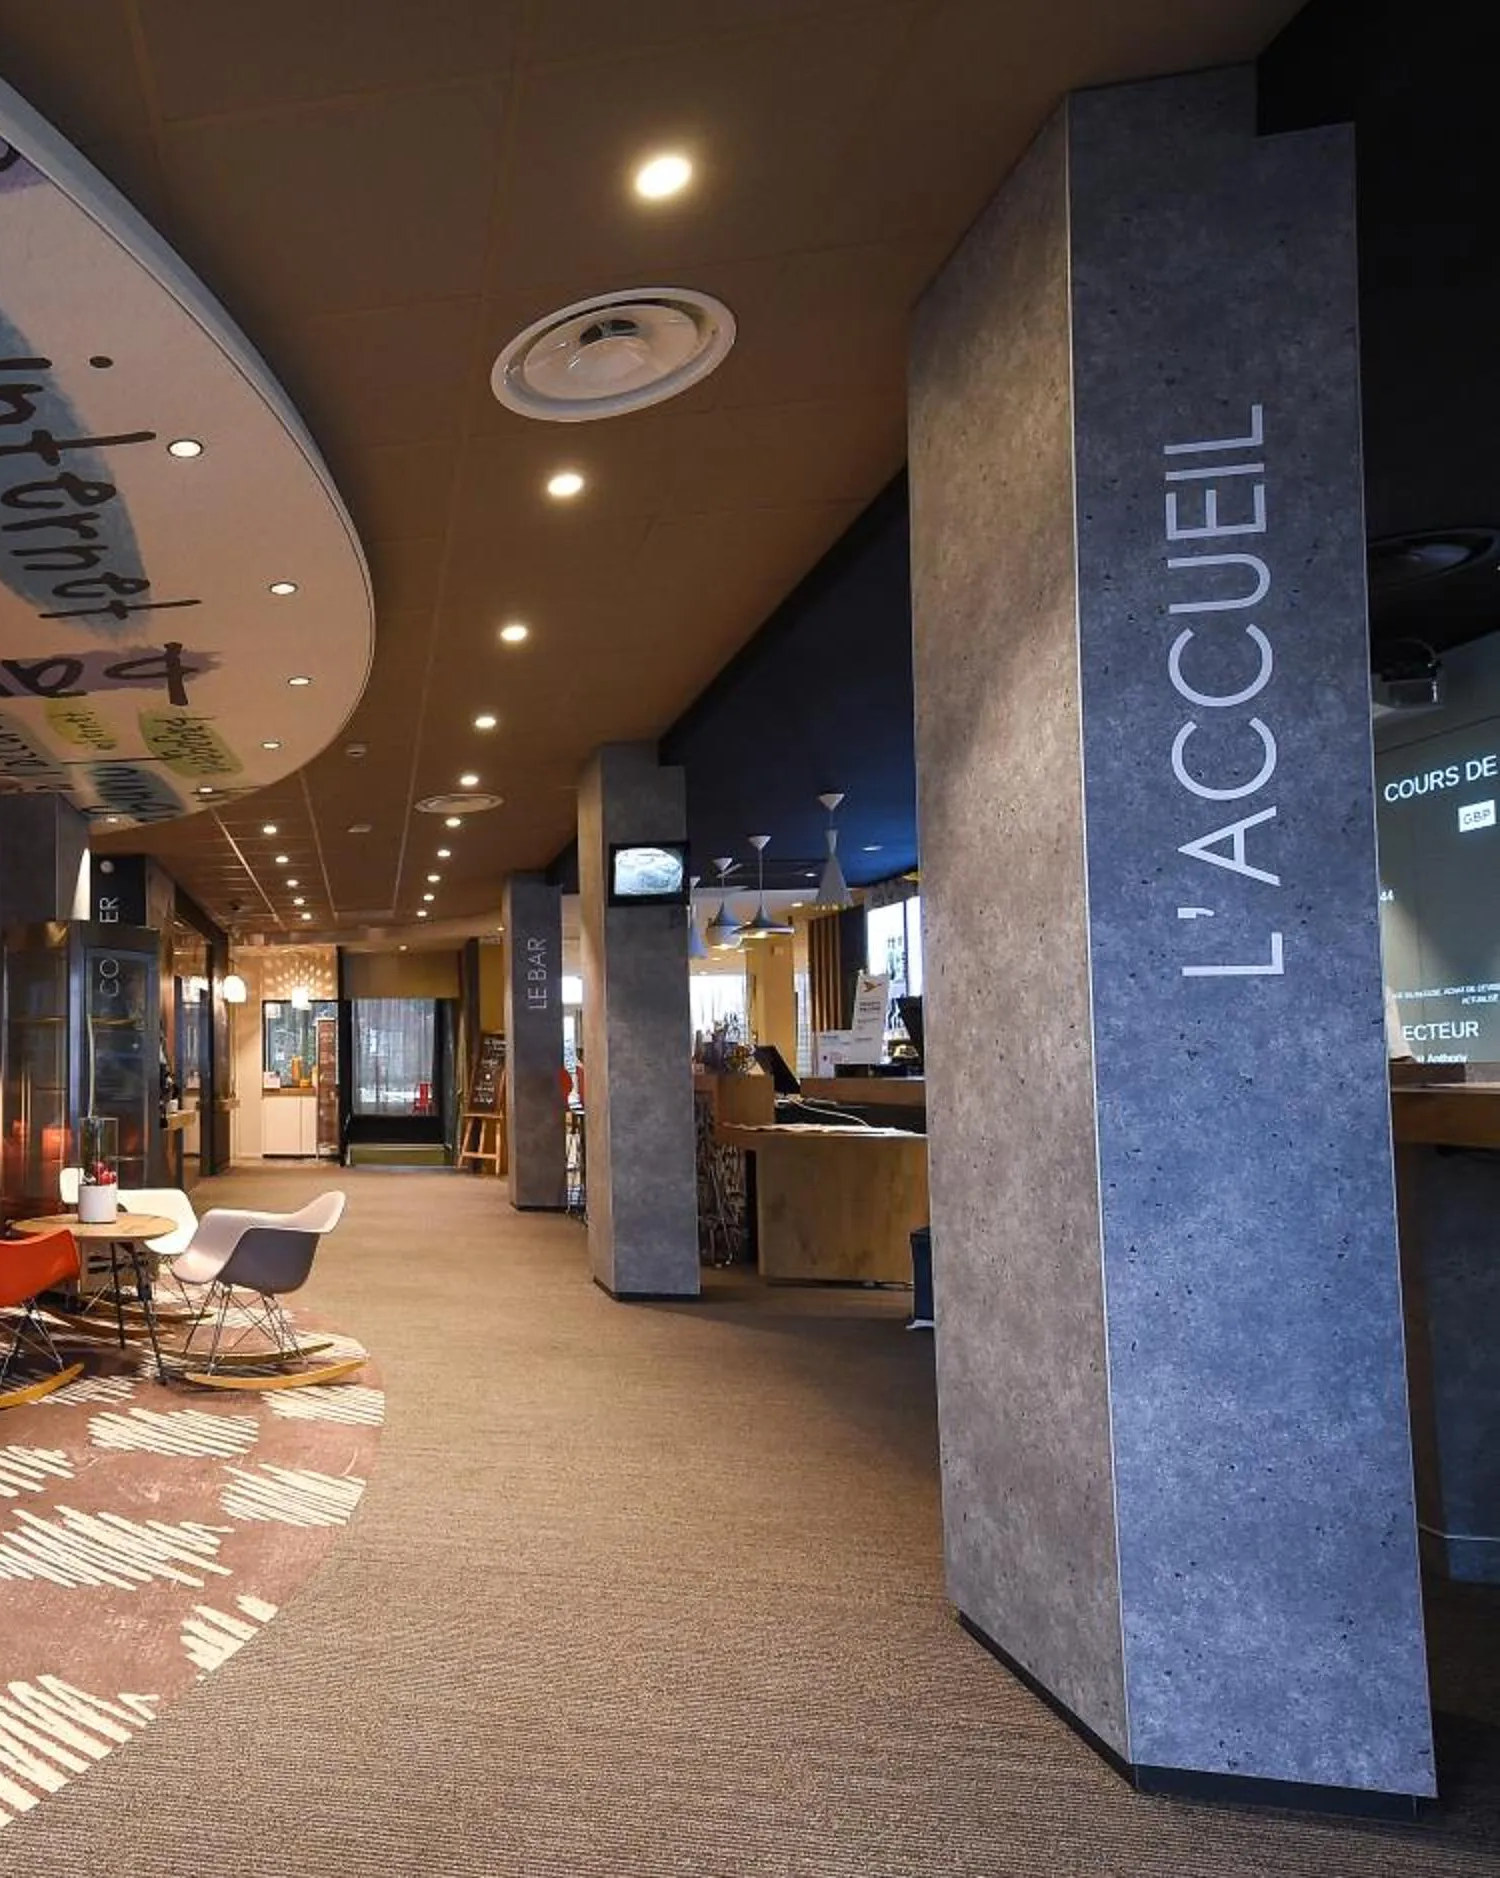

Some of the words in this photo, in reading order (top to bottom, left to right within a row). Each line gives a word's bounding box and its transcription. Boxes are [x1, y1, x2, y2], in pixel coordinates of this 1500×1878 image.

[1163, 403, 1285, 977] L'ACCUEIL
[1384, 765, 1460, 802] COURS
[1465, 754, 1499, 781] DE
[1463, 808, 1491, 825] GBP
[99, 896, 120, 997] COER
[527, 937, 548, 981] BAR
[527, 987, 548, 1010] LE
